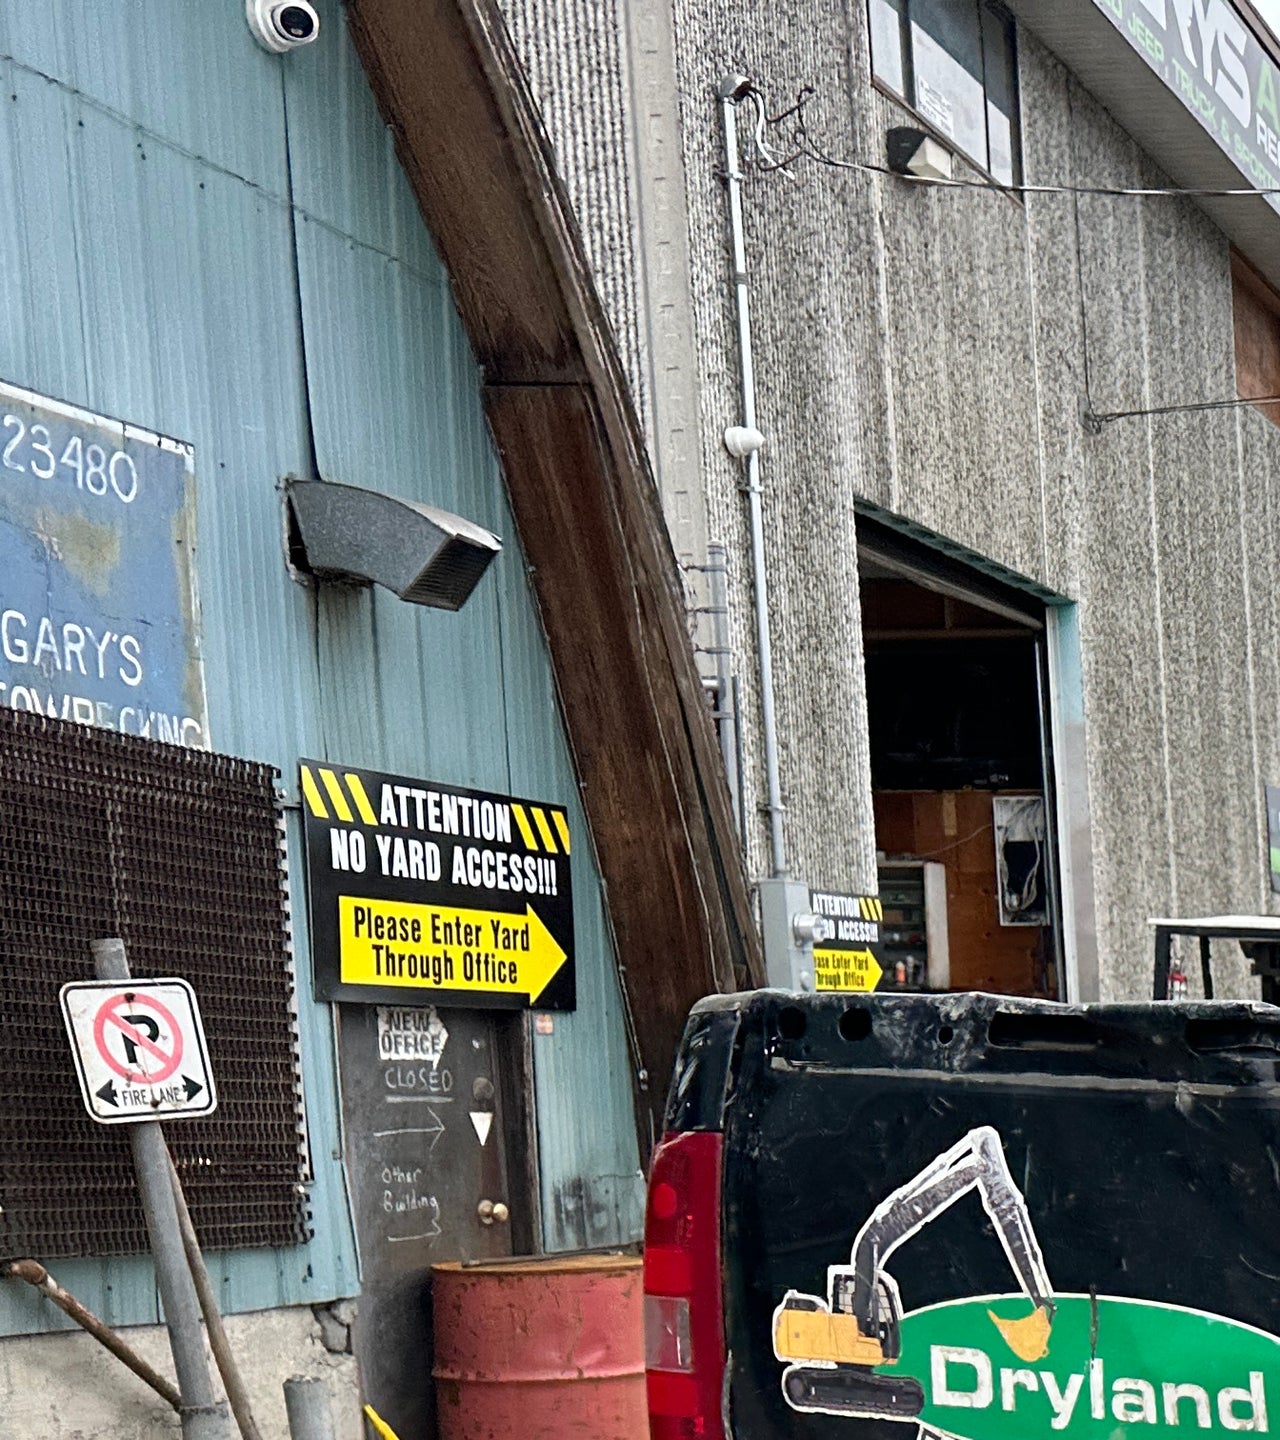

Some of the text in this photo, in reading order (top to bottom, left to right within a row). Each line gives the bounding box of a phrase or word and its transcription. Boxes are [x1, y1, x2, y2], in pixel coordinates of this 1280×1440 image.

[1172, 57, 1217, 129] TRUCK
[2, 414, 138, 503] 23480
[1, 609, 143, 687] GARY'S
[380, 783, 512, 843] ATTENTION
[330, 828, 558, 896] NO YARD ACCESS!!!
[354, 905, 530, 952] Please Enter Yard
[813, 893, 860, 918] ATTENTION
[372, 944, 518, 985] Through Office
[381, 1031, 441, 1055] OFFICE
[388, 1009, 430, 1032] NEW
[122, 1089, 149, 1107] FIRE
[385, 1066, 453, 1092] CLOSED
[929, 1344, 1269, 1433] Dryland
